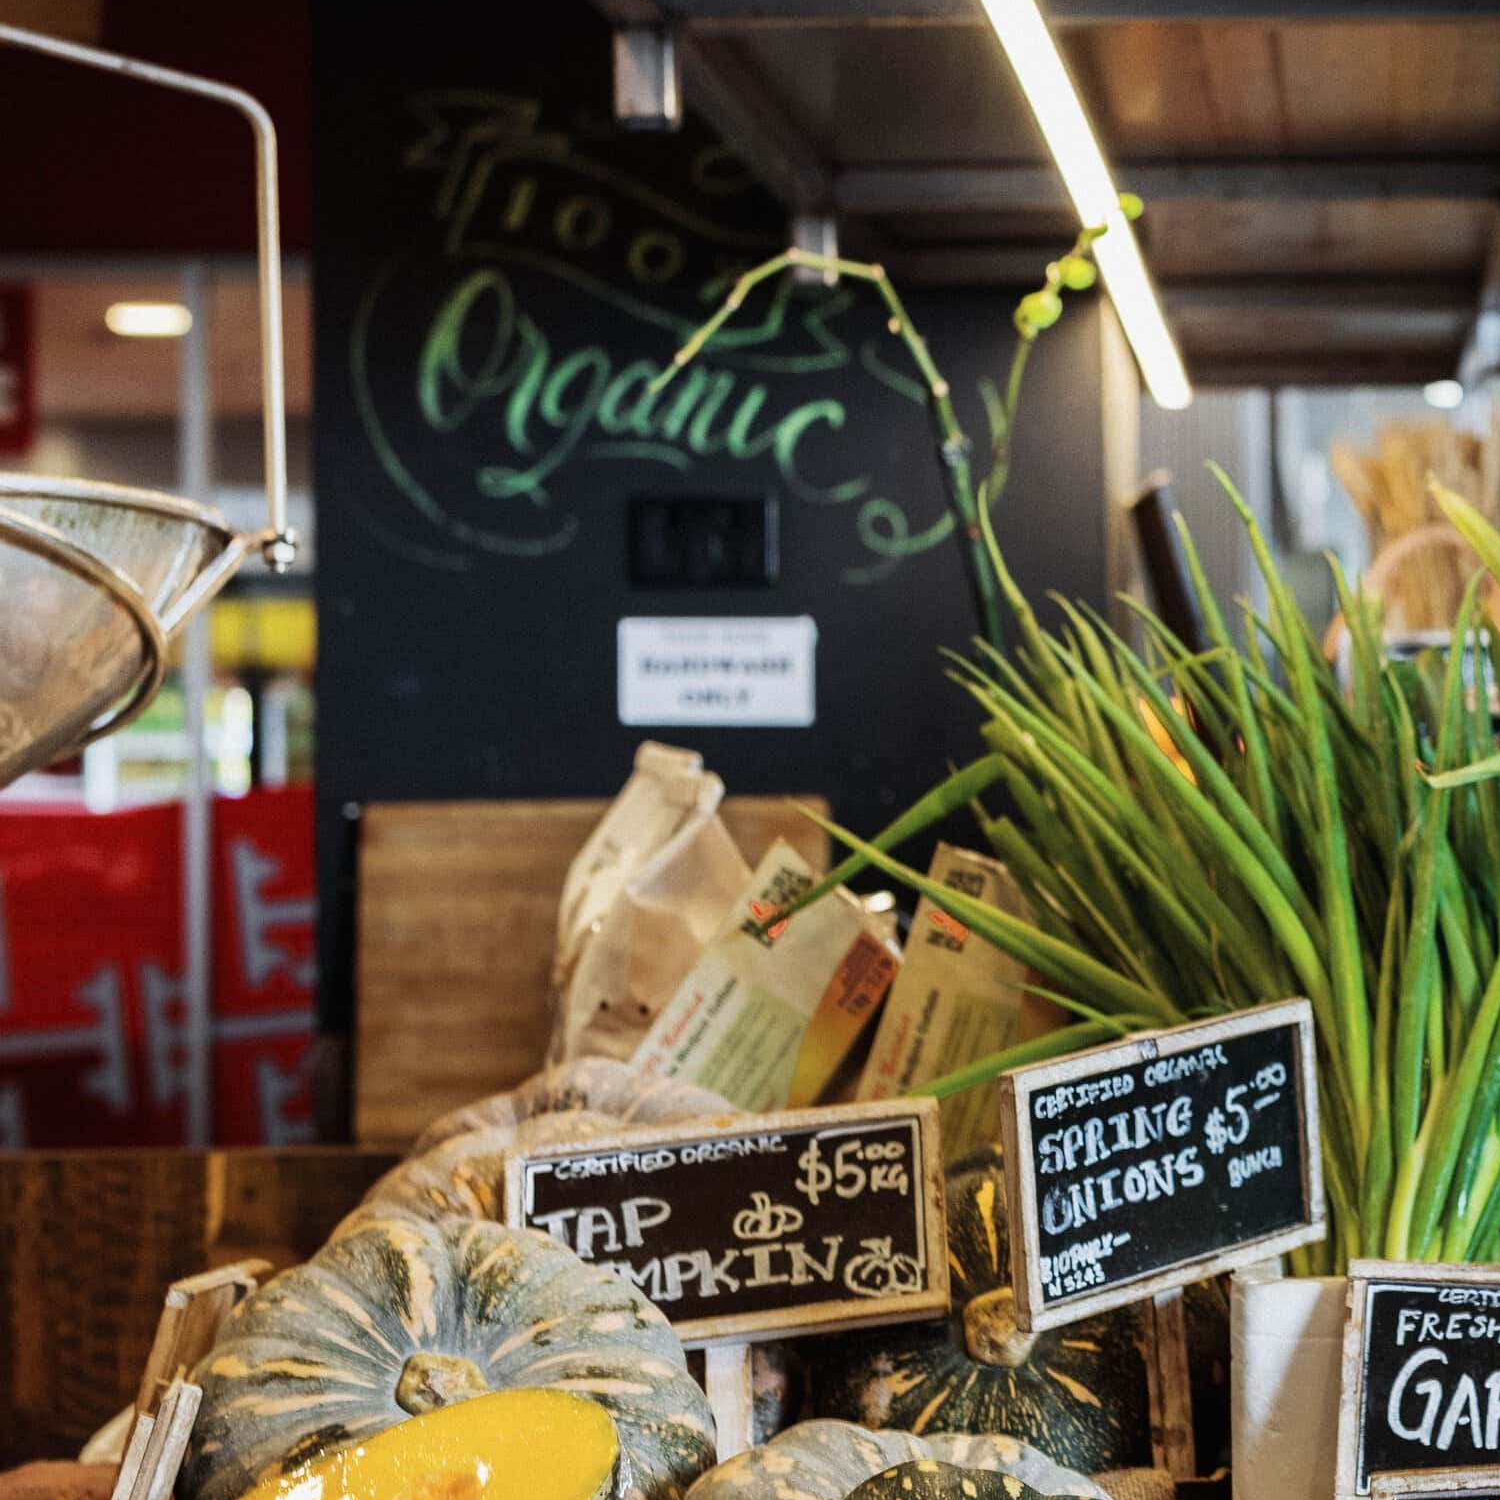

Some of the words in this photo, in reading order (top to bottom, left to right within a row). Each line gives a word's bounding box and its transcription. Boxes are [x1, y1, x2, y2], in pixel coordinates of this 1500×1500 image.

[419, 268, 868, 502] Organic
[1035, 1073, 1134, 1119] CERTIFIED
[554, 1148, 676, 1180] CERTIFIED
[1038, 1096, 1193, 1174] SPRING
[1043, 1147, 1204, 1235] ONIONS
[597, 1236, 843, 1301] MPKIN
